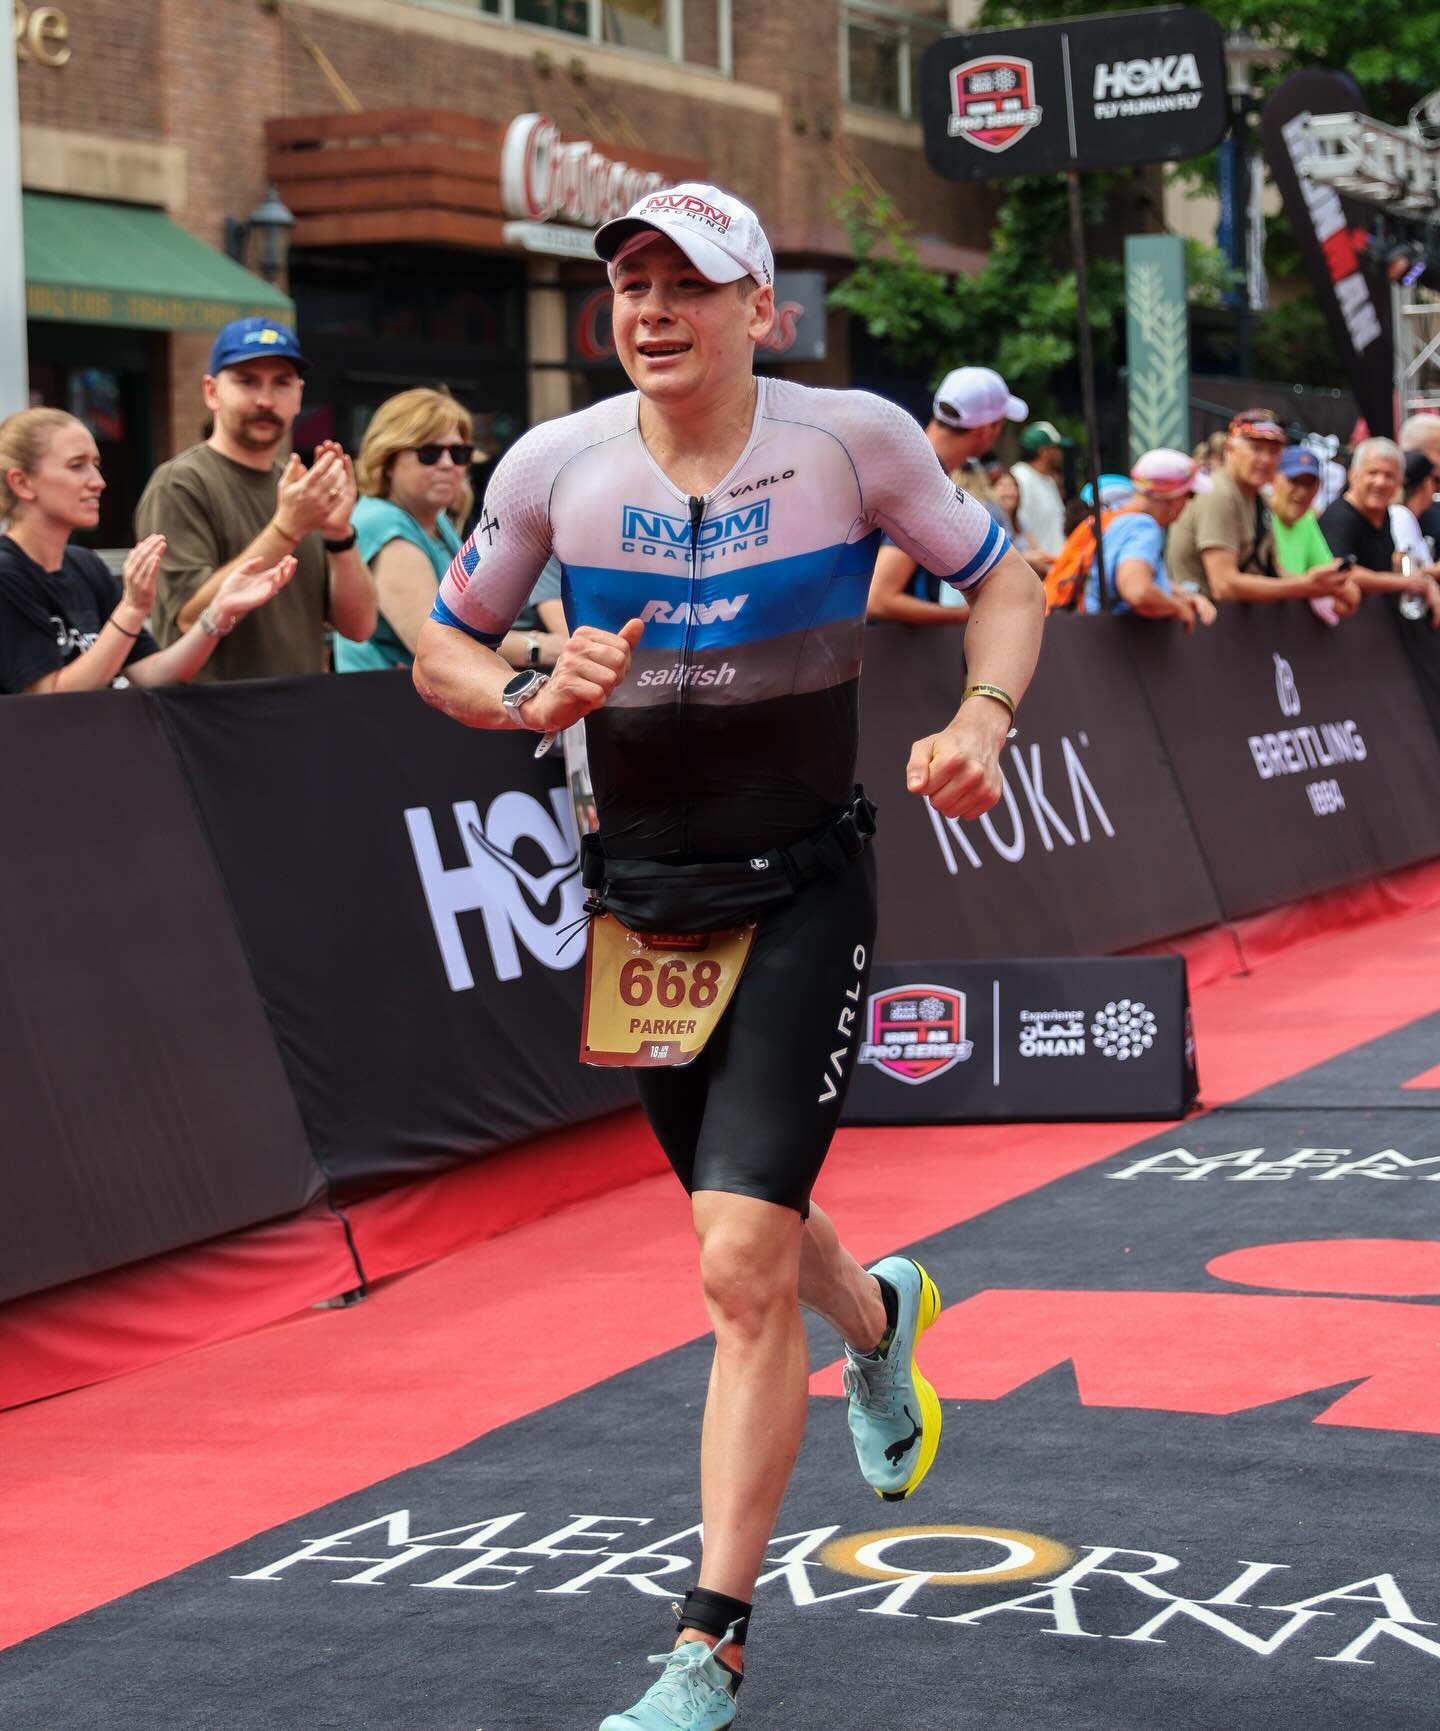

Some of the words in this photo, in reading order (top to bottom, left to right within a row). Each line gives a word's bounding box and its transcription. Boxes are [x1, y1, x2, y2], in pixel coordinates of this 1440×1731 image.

[1093, 53, 1203, 100] HOKA
[639, 209, 727, 235] COACHING
[645, 194, 732, 231] NVDM
[729, 470, 795, 498] VARLO
[622, 498, 770, 549] NVDM
[622, 535, 769, 563] COACHING
[640, 593, 750, 626] RAW
[637, 662, 736, 691] sailfish
[1248, 720, 1367, 779] BREITLING
[403, 786, 587, 992] HO
[619, 957, 722, 1009] 668
[629, 1018, 697, 1035] PARKER
[818, 944, 866, 1102] VARLO
[1019, 1009, 1085, 1023] Experience
[1019, 1037, 1086, 1058] OMAN
